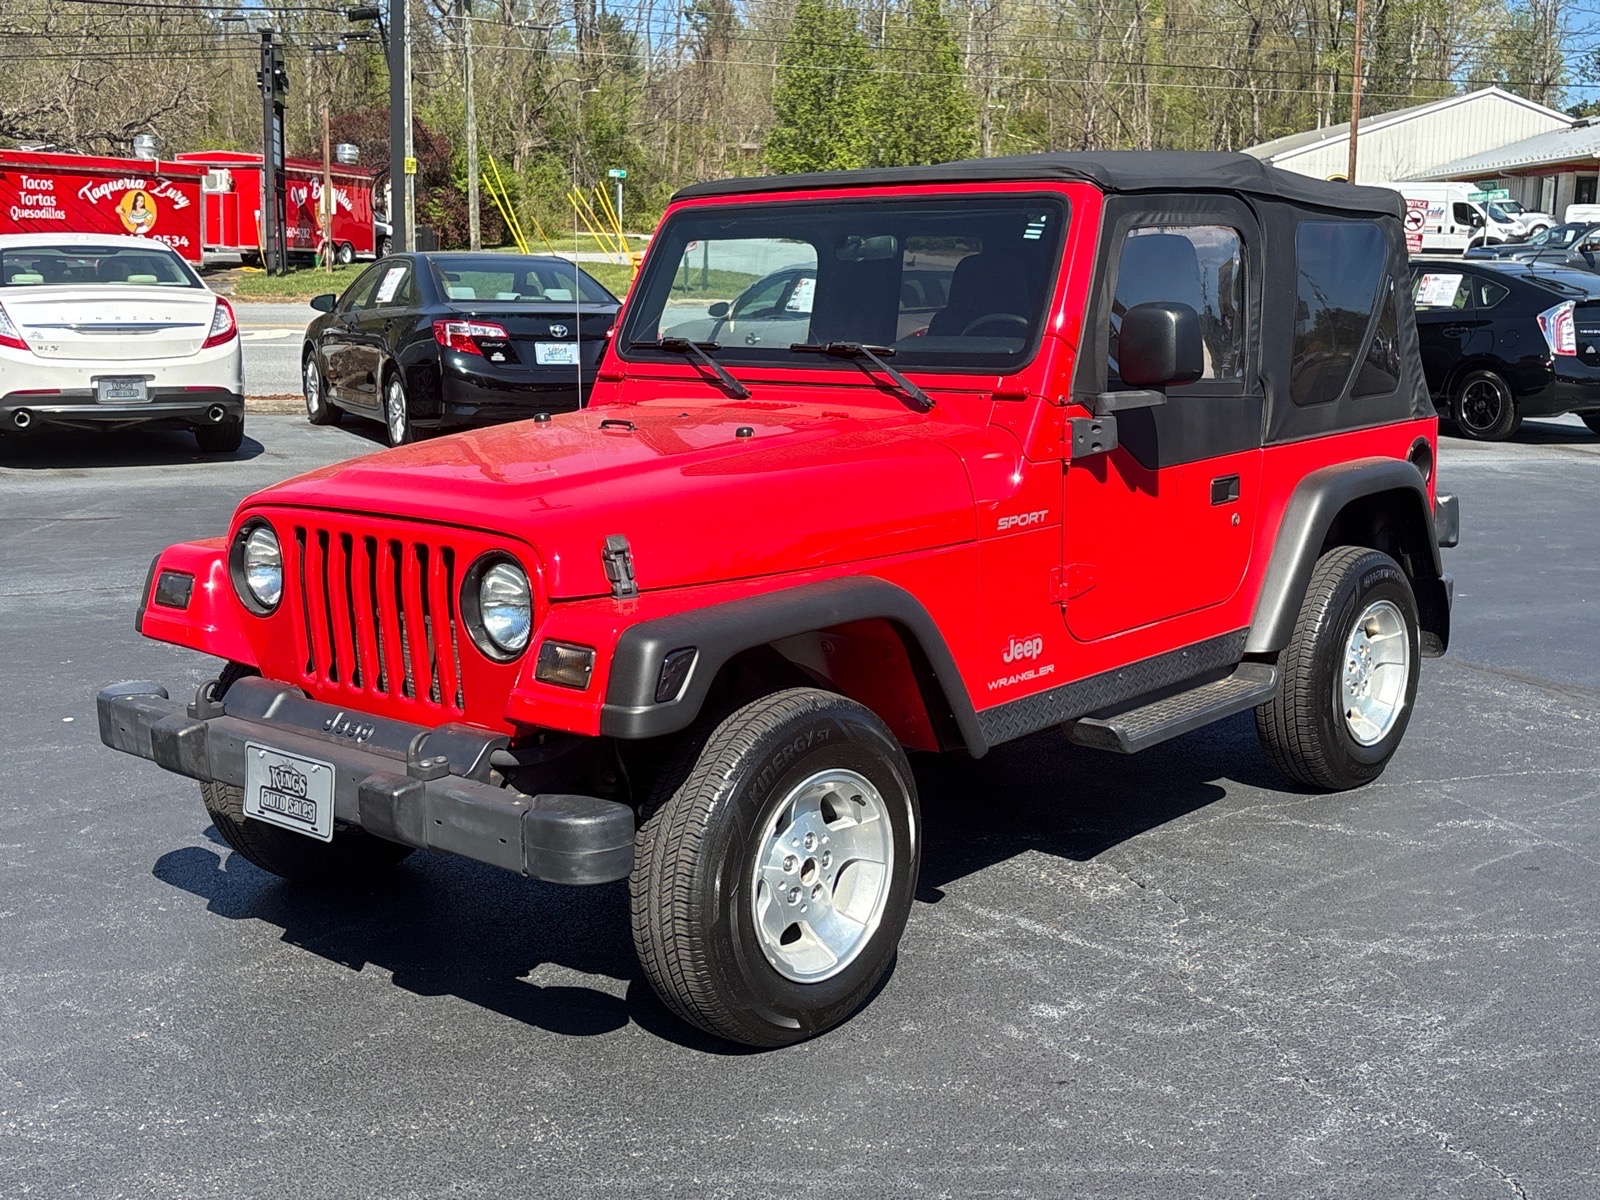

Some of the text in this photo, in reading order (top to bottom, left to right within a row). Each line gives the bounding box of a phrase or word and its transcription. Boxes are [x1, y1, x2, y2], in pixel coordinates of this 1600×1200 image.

[20, 175, 54, 191] Tacos
[77, 176, 192, 210] Taqueria Zury
[19, 191, 57, 207] Tortas
[10, 206, 66, 221] Quesadillas
[997, 510, 1048, 530] SPORT
[1003, 636, 1043, 663] Jeep
[987, 663, 1055, 691] WRANGLER
[322, 711, 375, 743] Jeep
